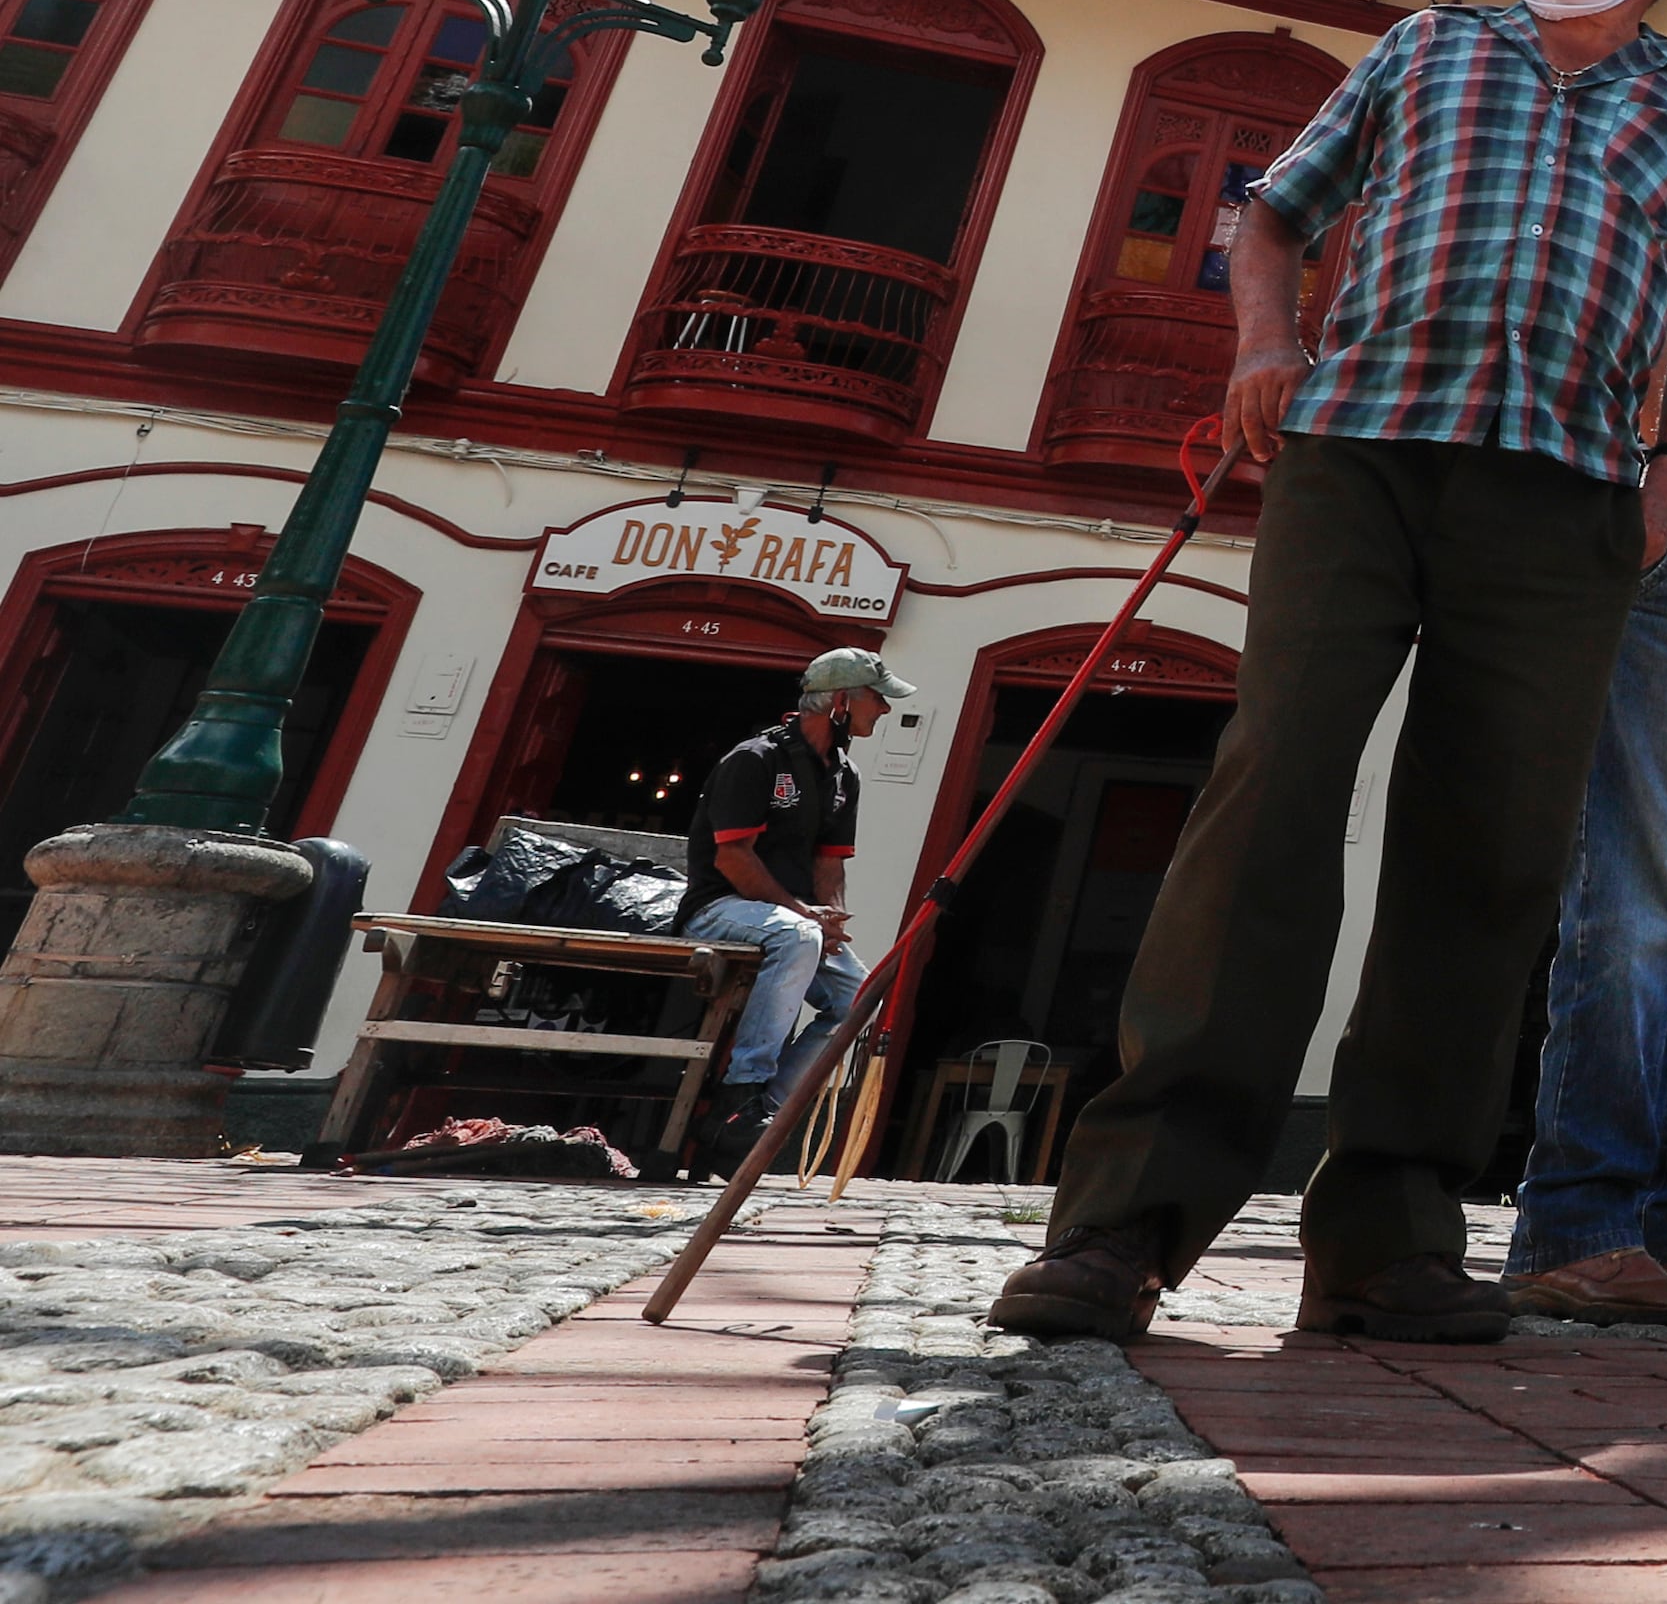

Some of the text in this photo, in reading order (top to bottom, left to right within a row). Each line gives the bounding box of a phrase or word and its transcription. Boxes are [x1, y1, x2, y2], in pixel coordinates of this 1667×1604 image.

[611, 519, 856, 587] DON RAFA
[544, 562, 599, 580] CAFE
[820, 593, 886, 612] JERICO
